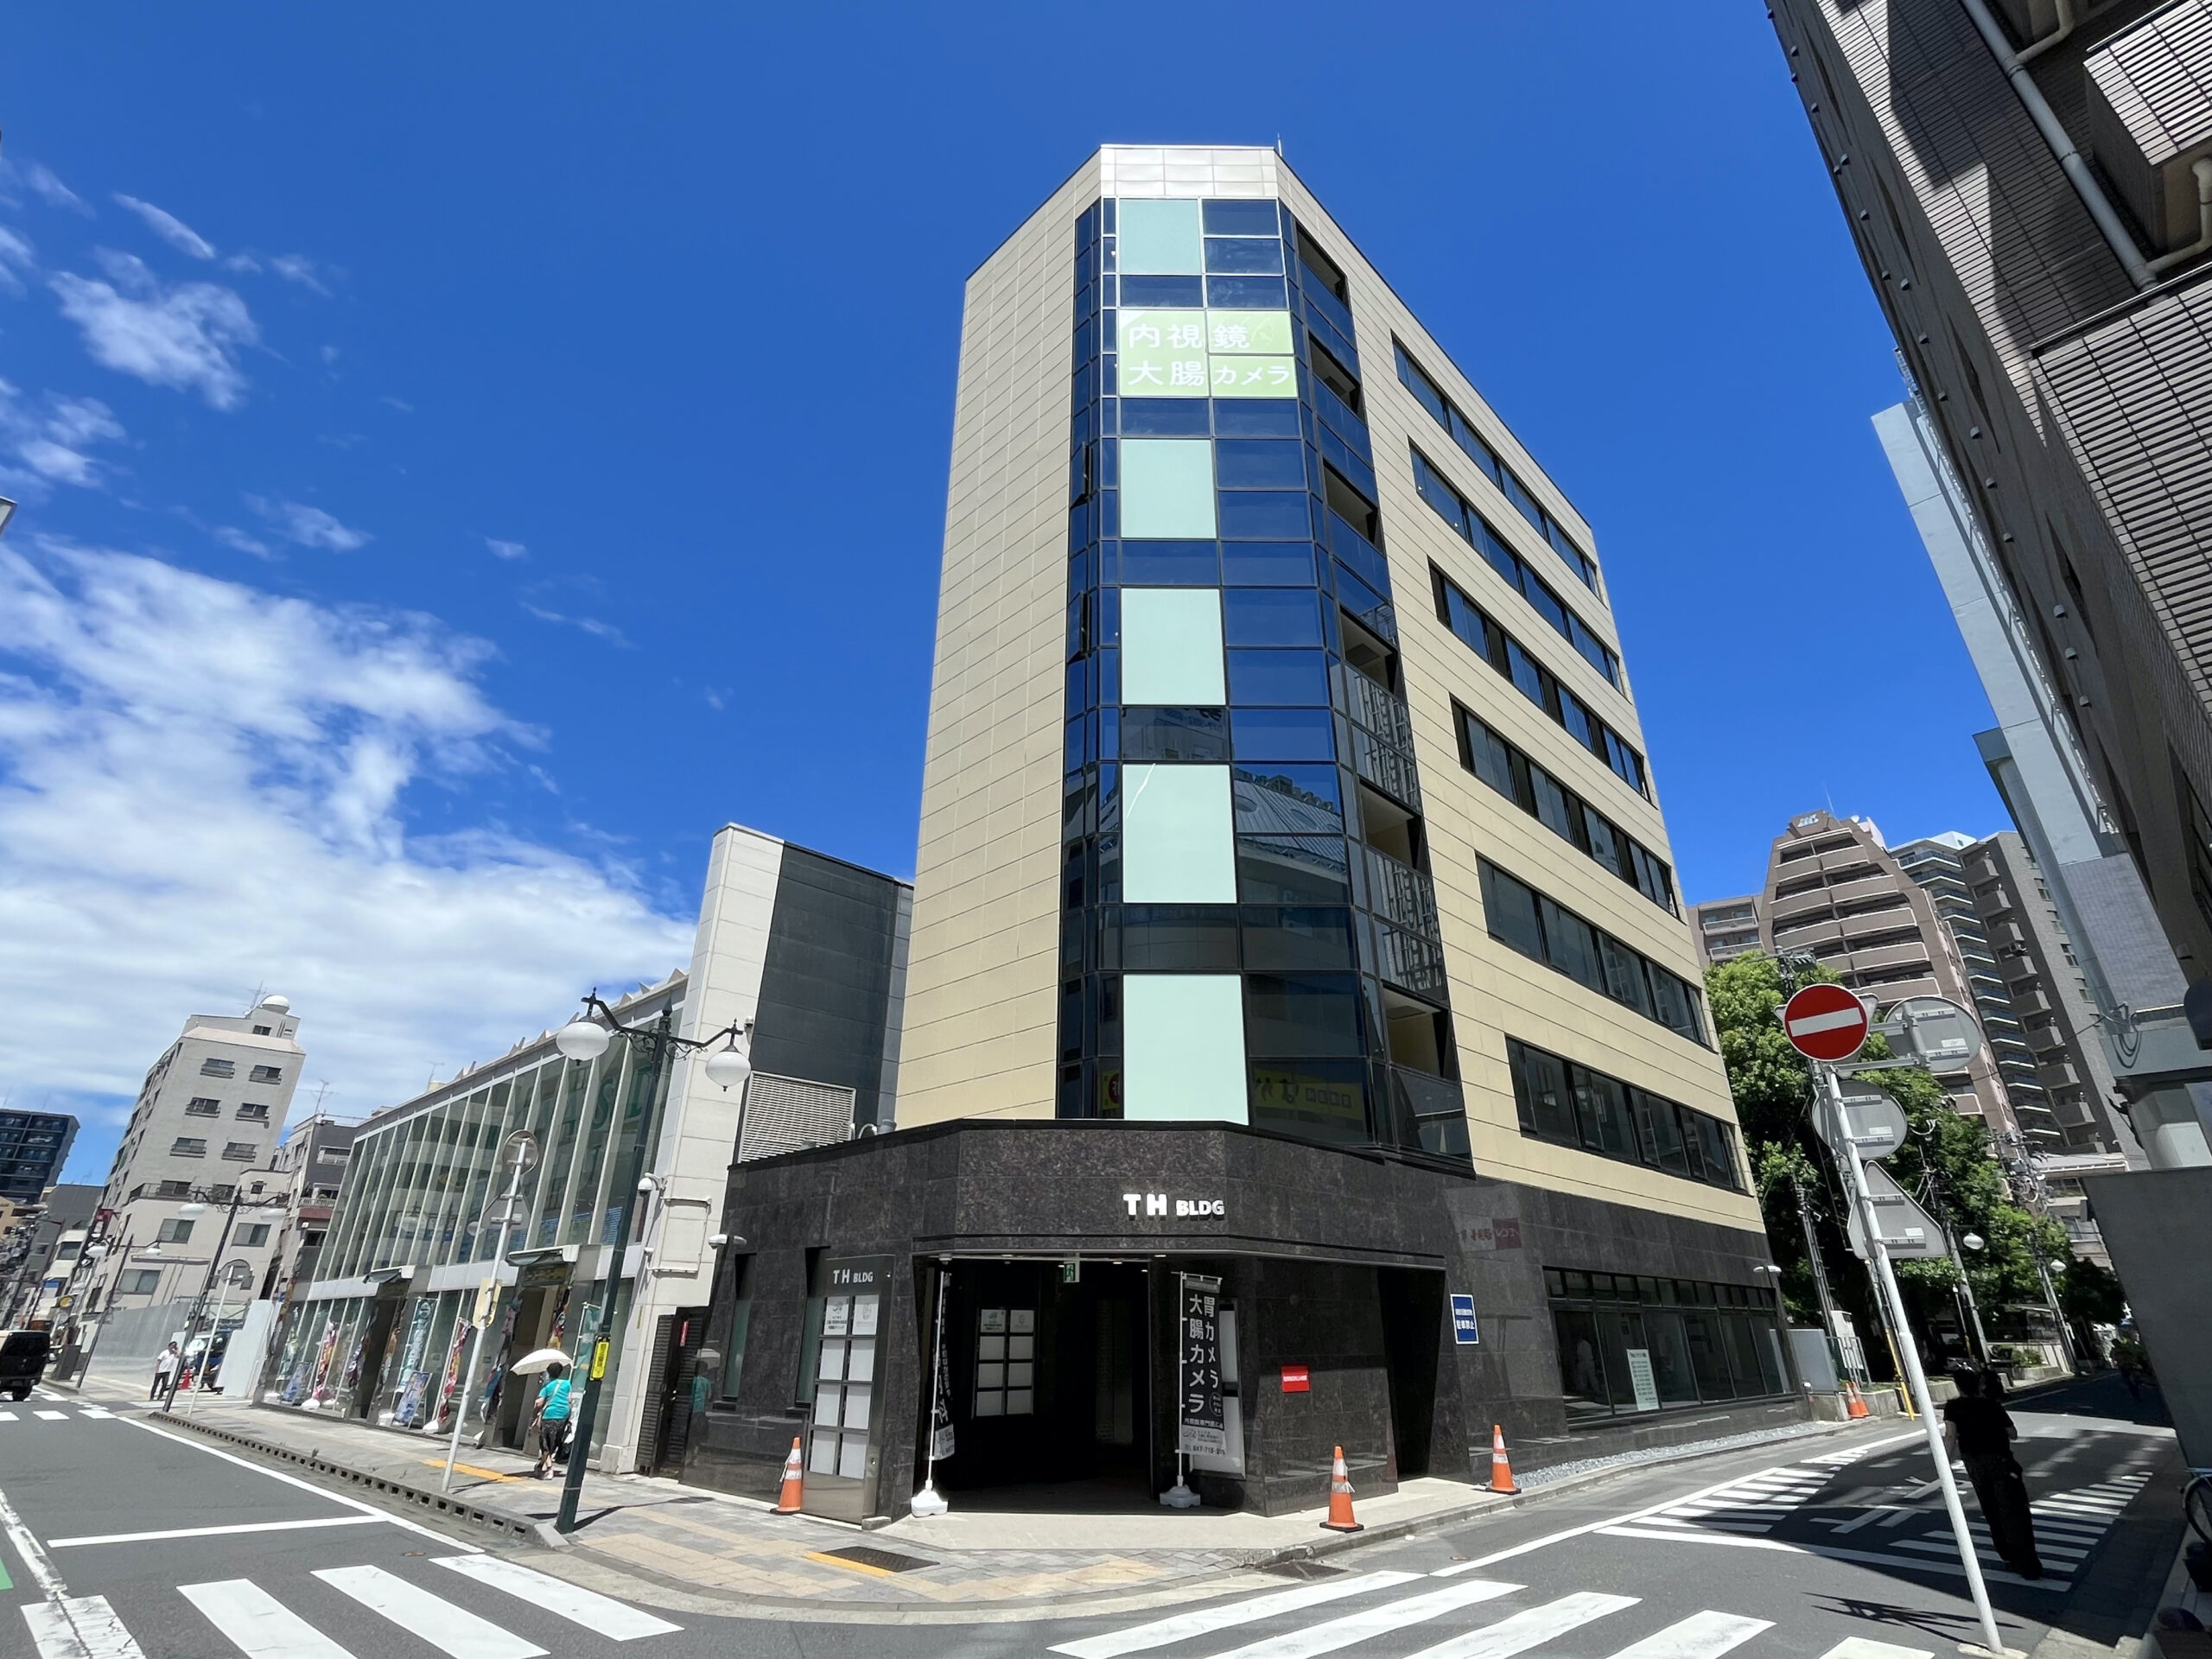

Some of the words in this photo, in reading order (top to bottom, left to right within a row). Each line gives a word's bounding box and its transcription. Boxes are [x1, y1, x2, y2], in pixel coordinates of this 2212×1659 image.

[1128, 323, 1250, 349] 内視鏡
[1128, 360, 1291, 387] 大腸カメラ
[1176, 1199, 1225, 1217] BLDG
[853, 1271, 874, 1284] BLDG
[1189, 1294, 1205, 1414] 大腸カメラ
[1204, 1296, 1219, 1389] 胃カメラ
